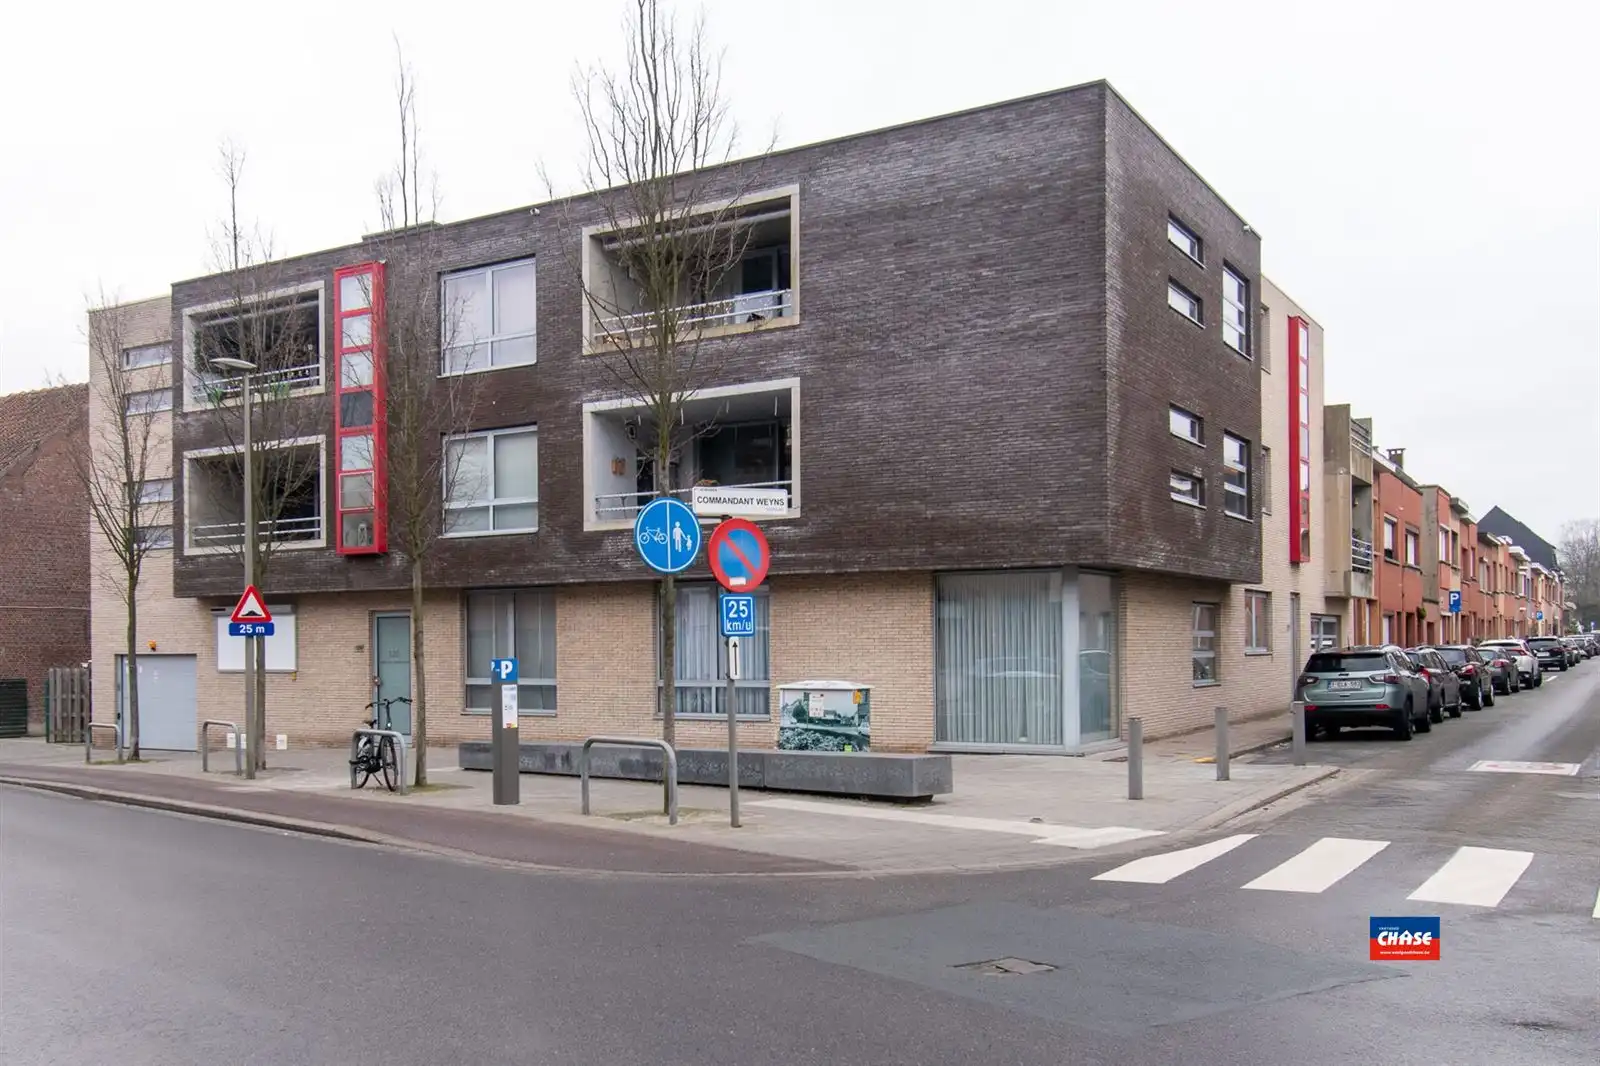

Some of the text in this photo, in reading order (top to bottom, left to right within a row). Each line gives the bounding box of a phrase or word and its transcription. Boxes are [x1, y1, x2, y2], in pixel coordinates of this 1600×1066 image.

[697, 496, 785, 506] COMMANDANT WEYNS
[1450, 593, 1459, 605] P
[728, 600, 748, 618] 25
[239, 624, 253, 634] 25
[726, 620, 752, 631] km/u
[501, 660, 513, 679] P
